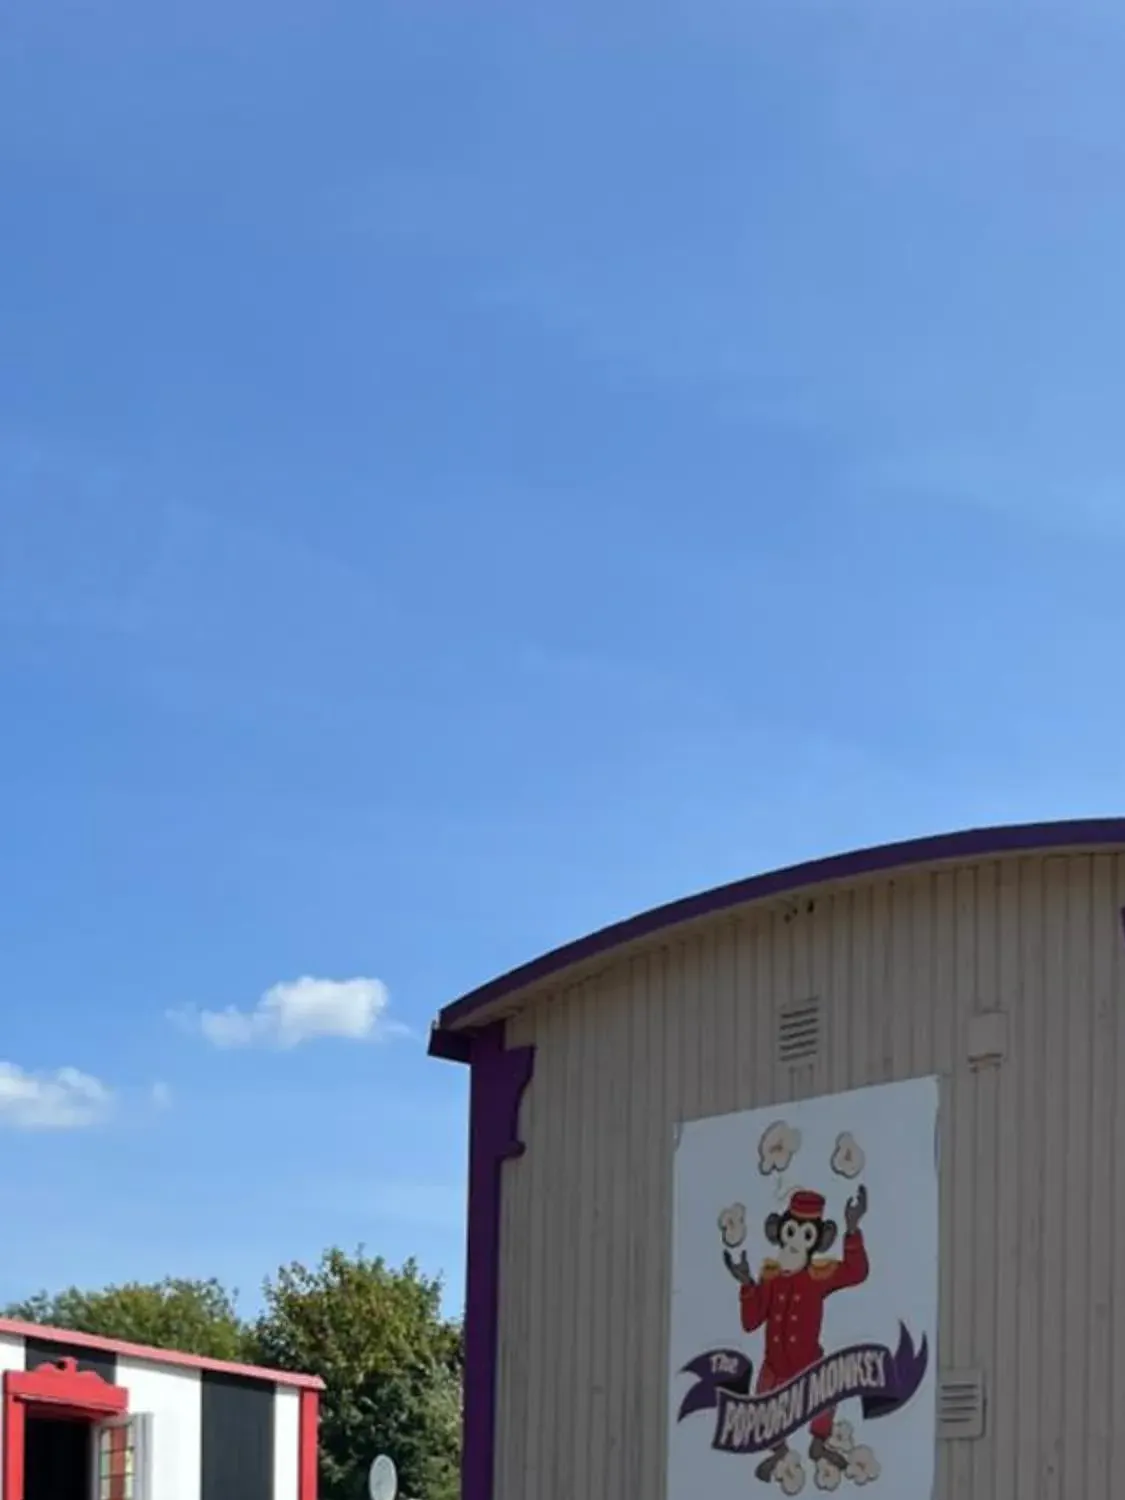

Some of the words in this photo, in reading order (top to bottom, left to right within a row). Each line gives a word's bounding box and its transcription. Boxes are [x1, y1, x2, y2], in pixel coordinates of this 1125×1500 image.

[710, 1354, 739, 1374] The
[721, 1382, 806, 1447] POPCORN
[807, 1351, 887, 1411] MONKEY
